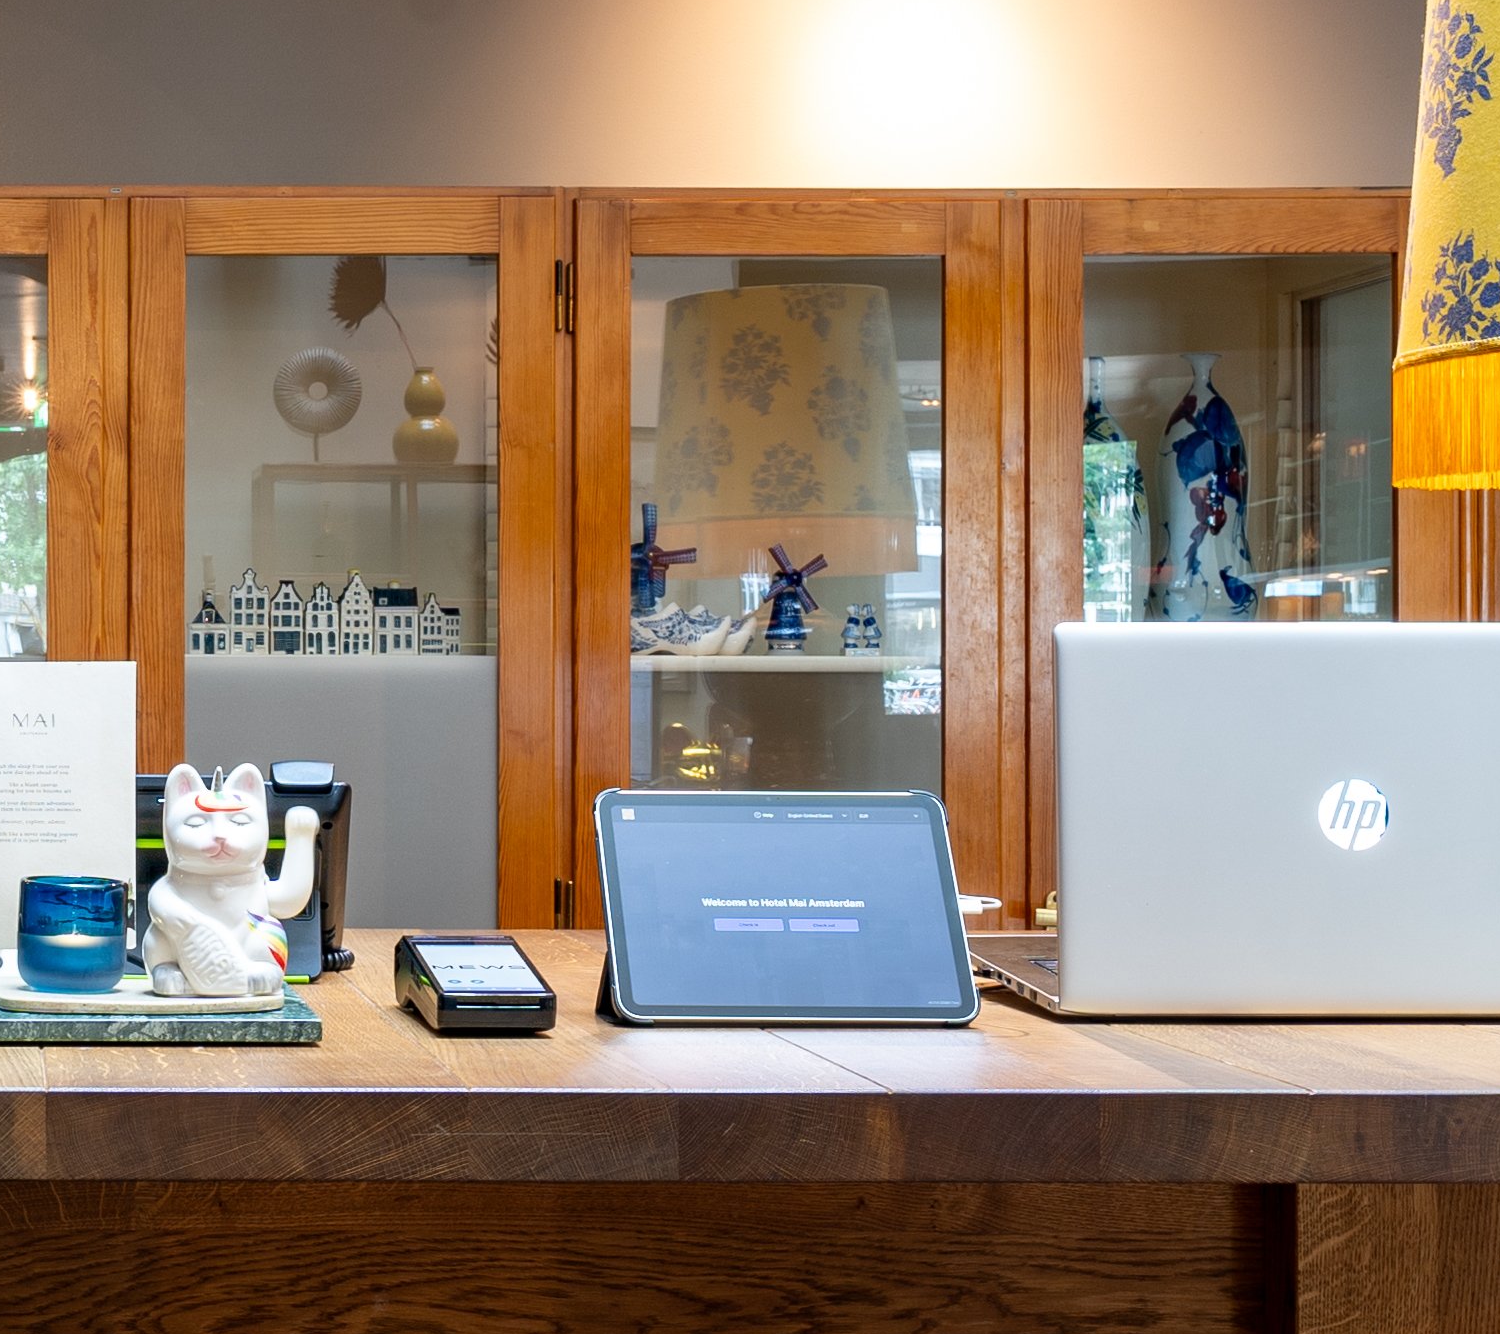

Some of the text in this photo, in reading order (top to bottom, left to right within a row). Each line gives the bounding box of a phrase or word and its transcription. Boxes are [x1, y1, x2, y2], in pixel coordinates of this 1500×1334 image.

[12, 713, 55, 727] MAI
[1329, 779, 1381, 850] hp
[701, 898, 747, 907] Welcome
[749, 898, 760, 907] to
[761, 898, 788, 908] Hotel
[808, 898, 865, 908] Amsterdam
